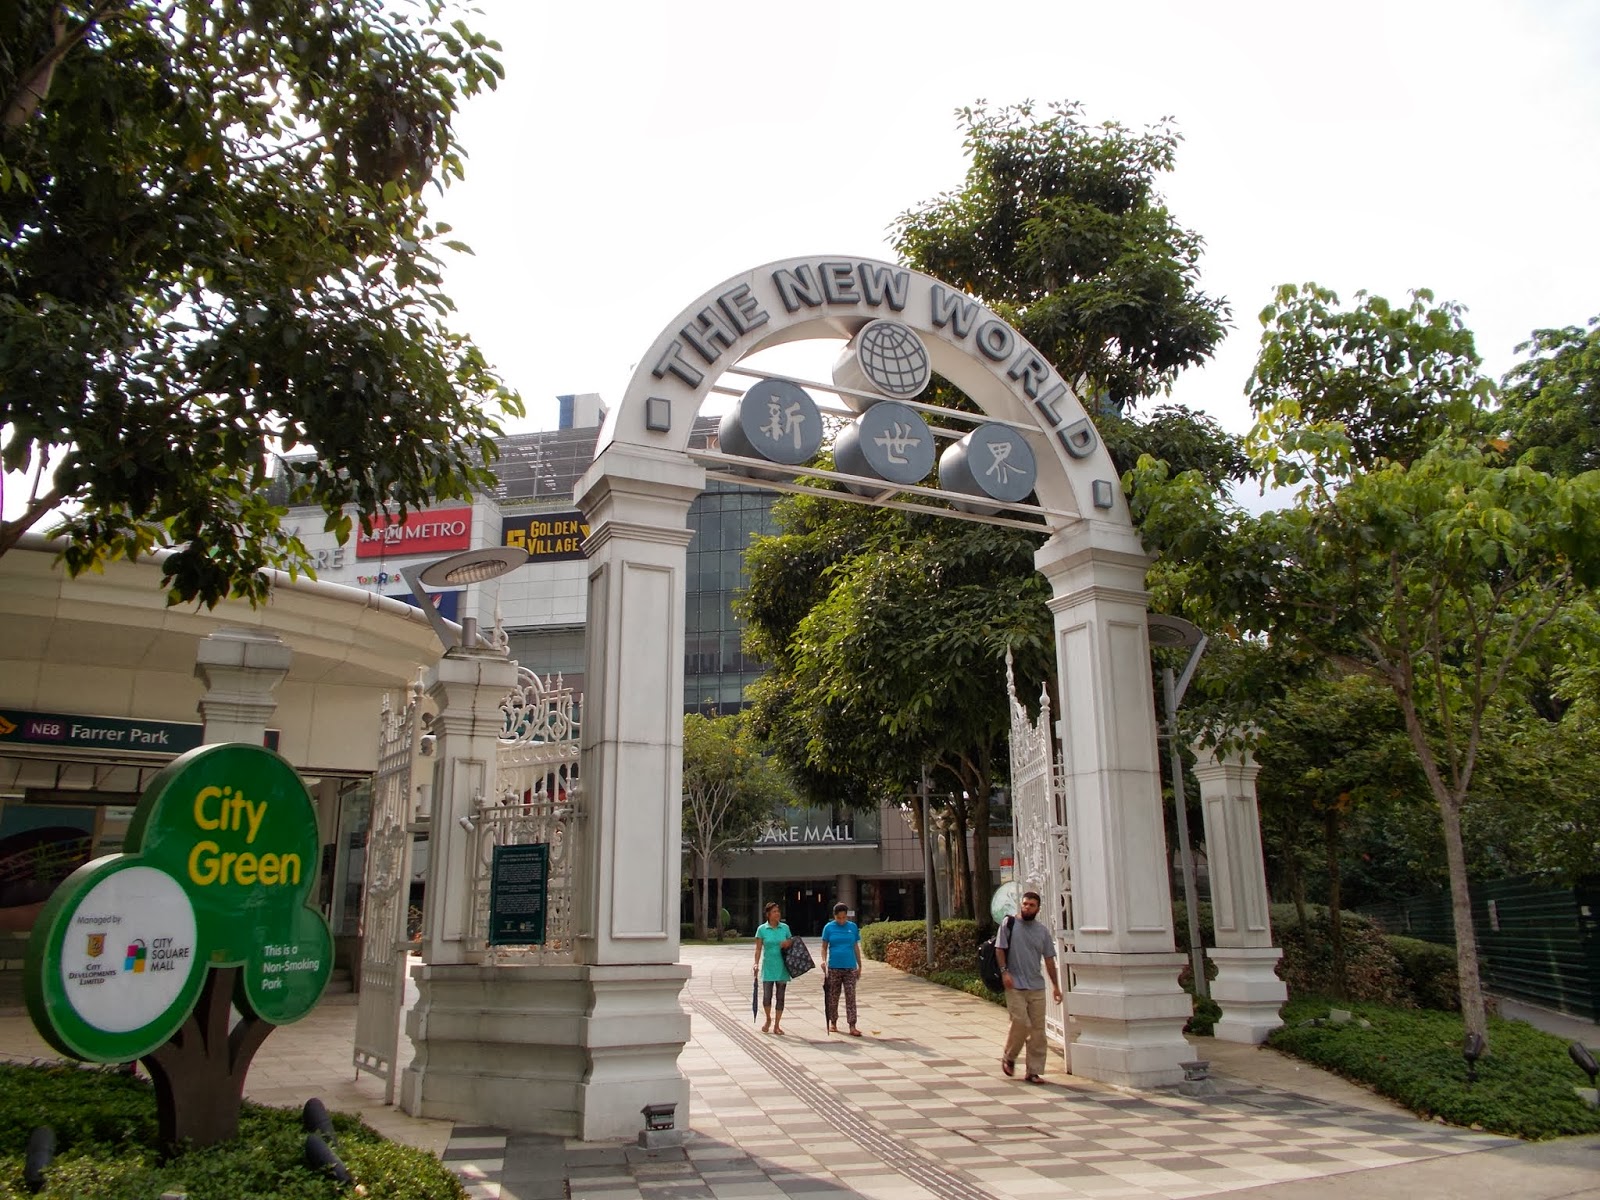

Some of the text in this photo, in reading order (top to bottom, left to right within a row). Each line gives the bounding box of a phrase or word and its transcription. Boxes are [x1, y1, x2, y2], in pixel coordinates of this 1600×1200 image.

[652, 262, 1098, 460] THE NEW WORLD
[405, 521, 466, 539] METRO
[531, 521, 578, 538] GOLDEN
[527, 537, 580, 555] VILLAGE
[31, 722, 170, 744] NE8 Farrer Park
[193, 785, 268, 844] City
[804, 825, 853, 842] MALL
[188, 840, 300, 886] Green
[77, 916, 112, 925] Managed
[152, 937, 173, 949] CITY
[264, 944, 298, 956] This is a
[151, 948, 190, 960] SQUARE
[150, 960, 175, 972] MALL
[263, 958, 320, 973] Non-Smoking
[262, 977, 282, 990] Park
